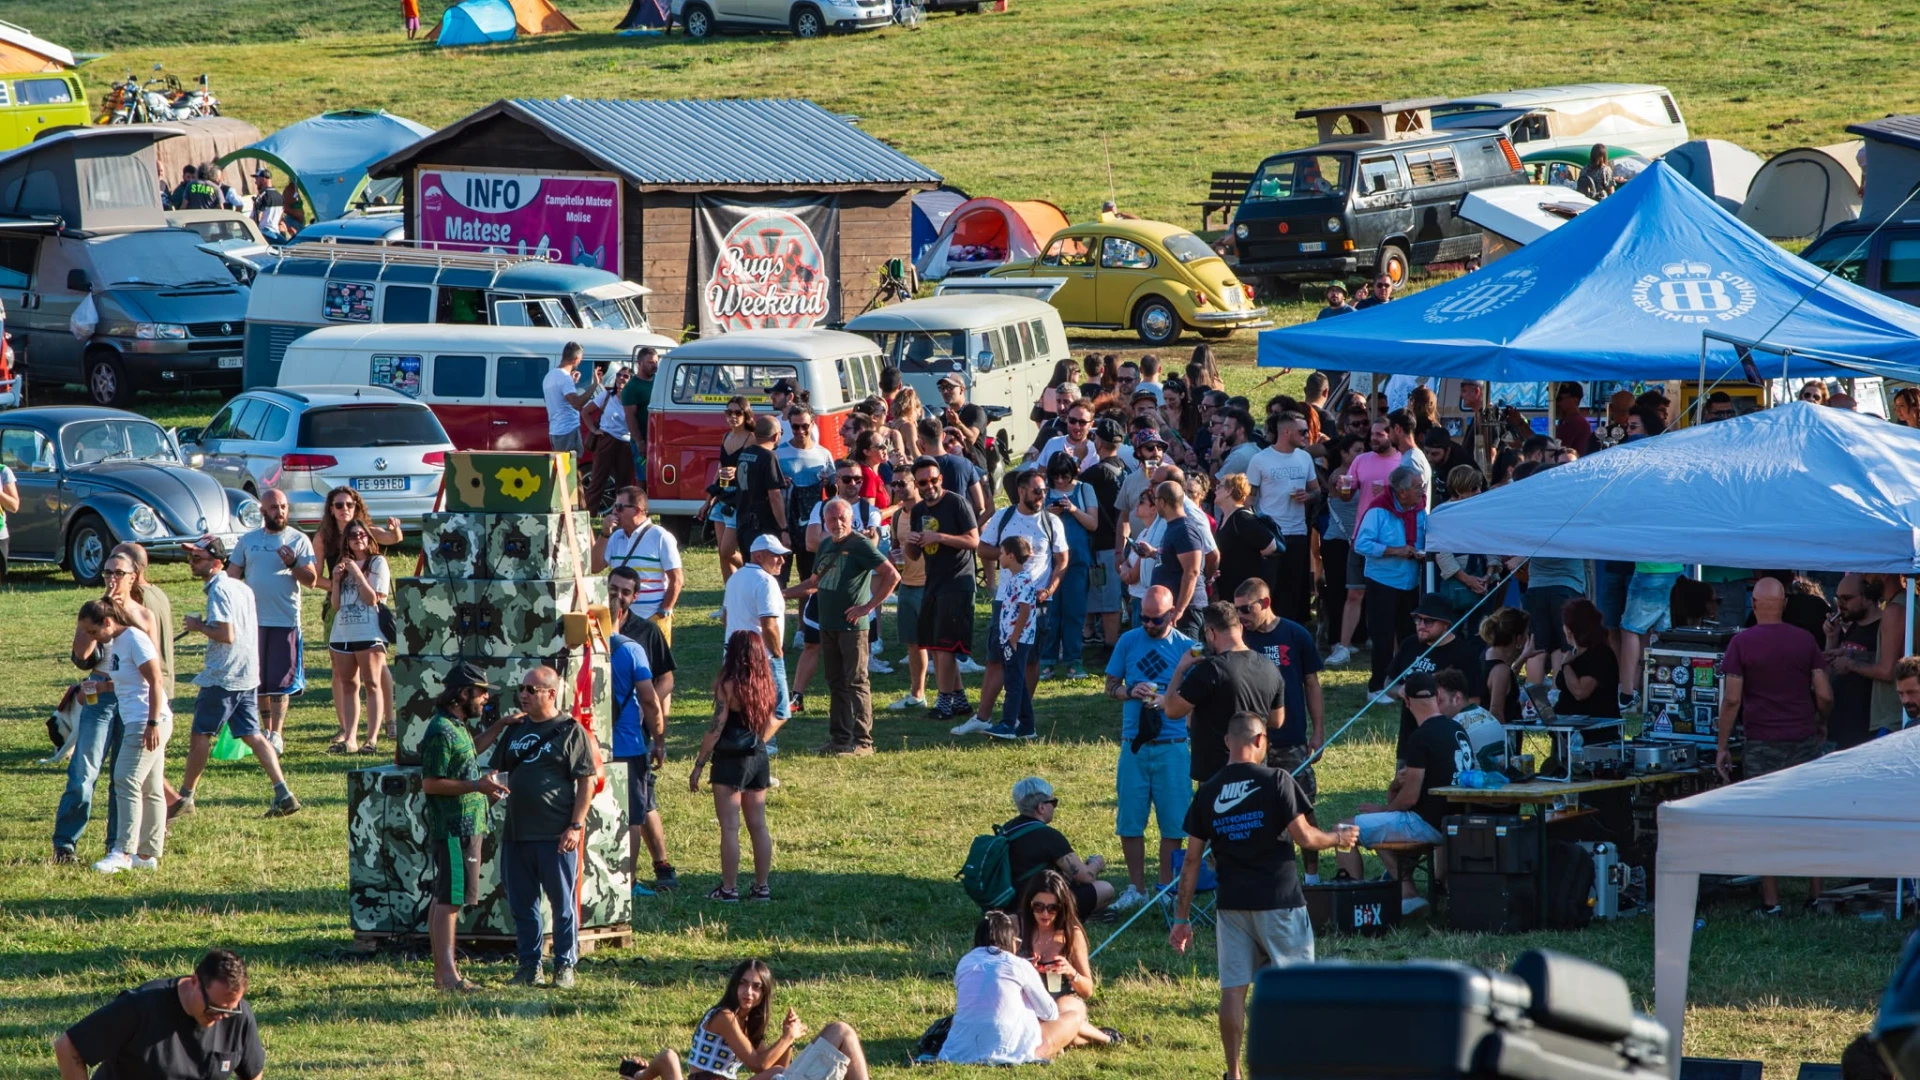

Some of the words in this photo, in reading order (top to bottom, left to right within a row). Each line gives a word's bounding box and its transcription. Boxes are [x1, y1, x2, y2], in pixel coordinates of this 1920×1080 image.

[466, 178, 520, 209] INFO
[545, 194, 584, 207] Campitello
[585, 195, 612, 207] Matese
[566, 211, 591, 223] Molise
[445, 216, 511, 242] Matese
[709, 282, 823, 316] Weekend
[1631, 274, 1711, 323] BAYREUTHER
[1715, 271, 1757, 321] BRAUHAUS
[1271, 465, 1306, 480] KARL
[357, 479, 370, 490] FE
[1263, 645, 1279, 653] THE
[509, 740, 531, 750] Hard
[1220, 780, 1250, 801] NIKE
[1212, 811, 1264, 827] AUTHORIZED
[1215, 820, 1264, 835] PERSONNEL
[1228, 830, 1250, 841] ONLY
